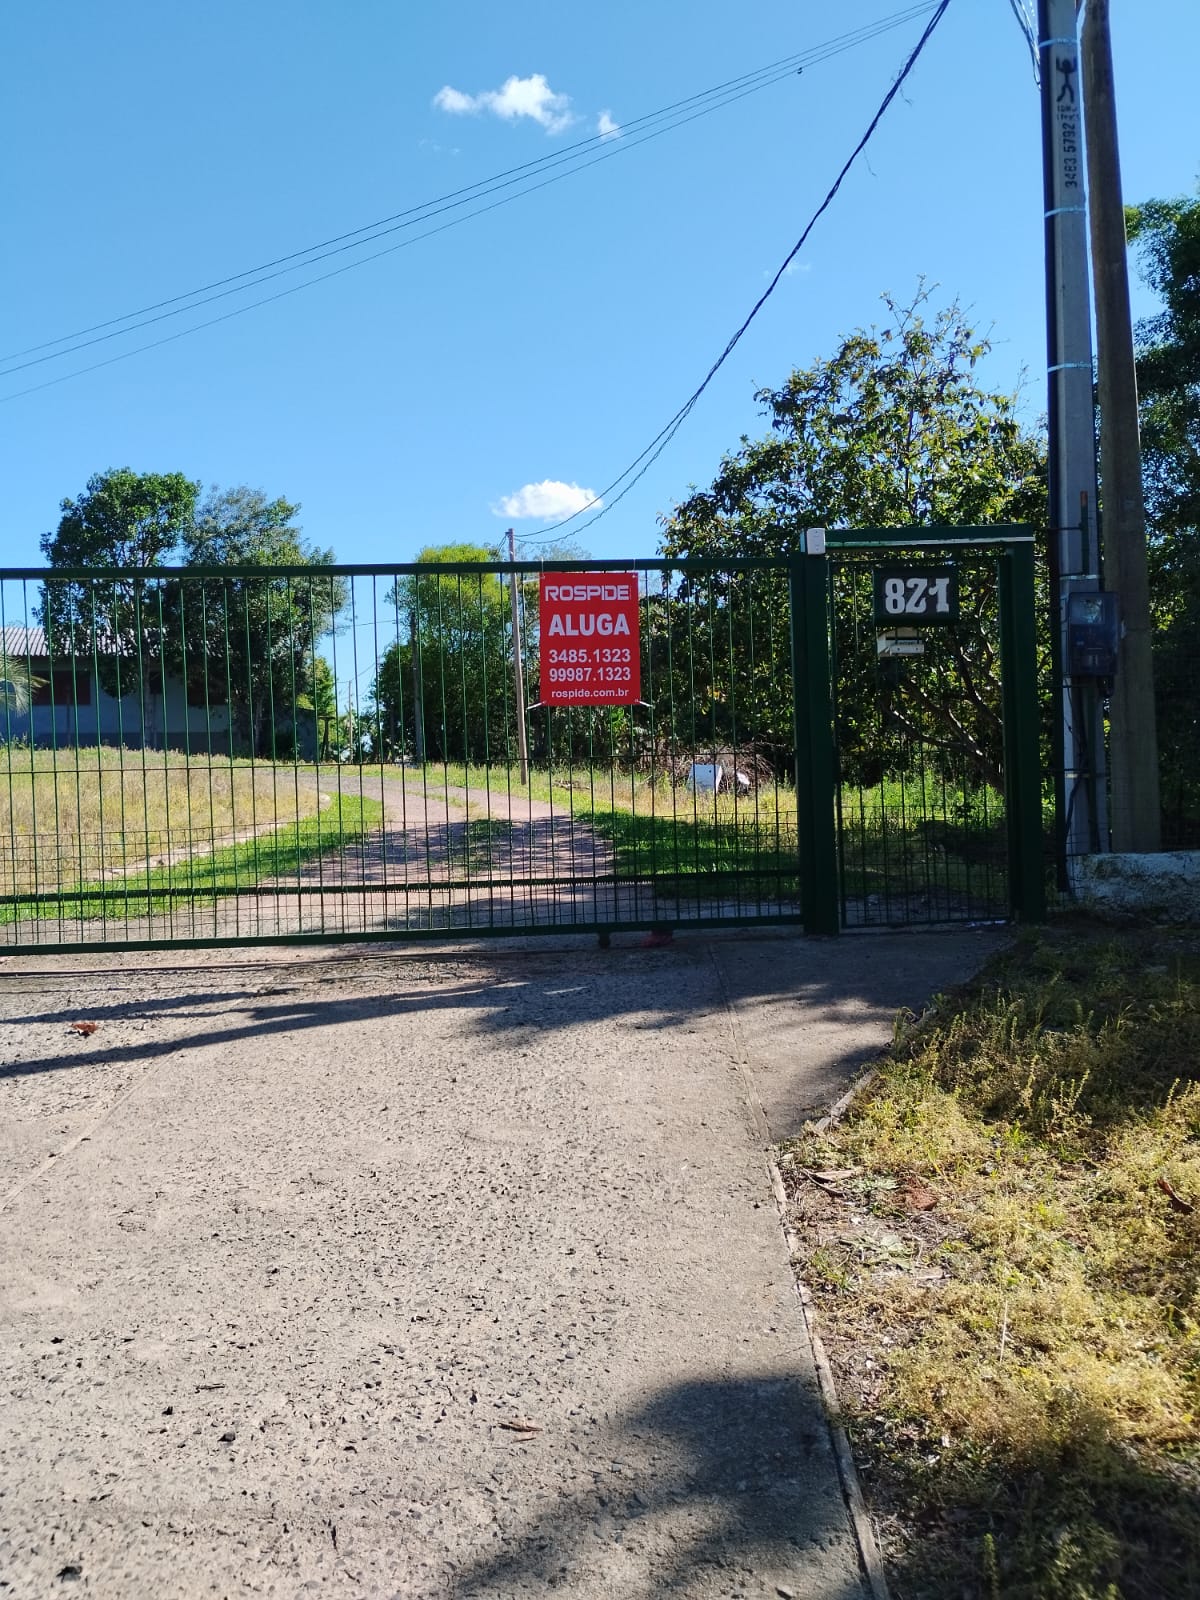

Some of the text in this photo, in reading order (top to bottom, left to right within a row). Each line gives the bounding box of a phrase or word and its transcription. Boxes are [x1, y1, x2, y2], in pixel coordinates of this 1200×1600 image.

[545, 585, 630, 601] ROSPIDE
[885, 578, 950, 614] 821
[548, 613, 631, 636] ALUGA
[549, 648, 631, 663] 3485.1323
[549, 667, 631, 682] 99987.1323
[551, 688, 630, 699] rospide.com.br
